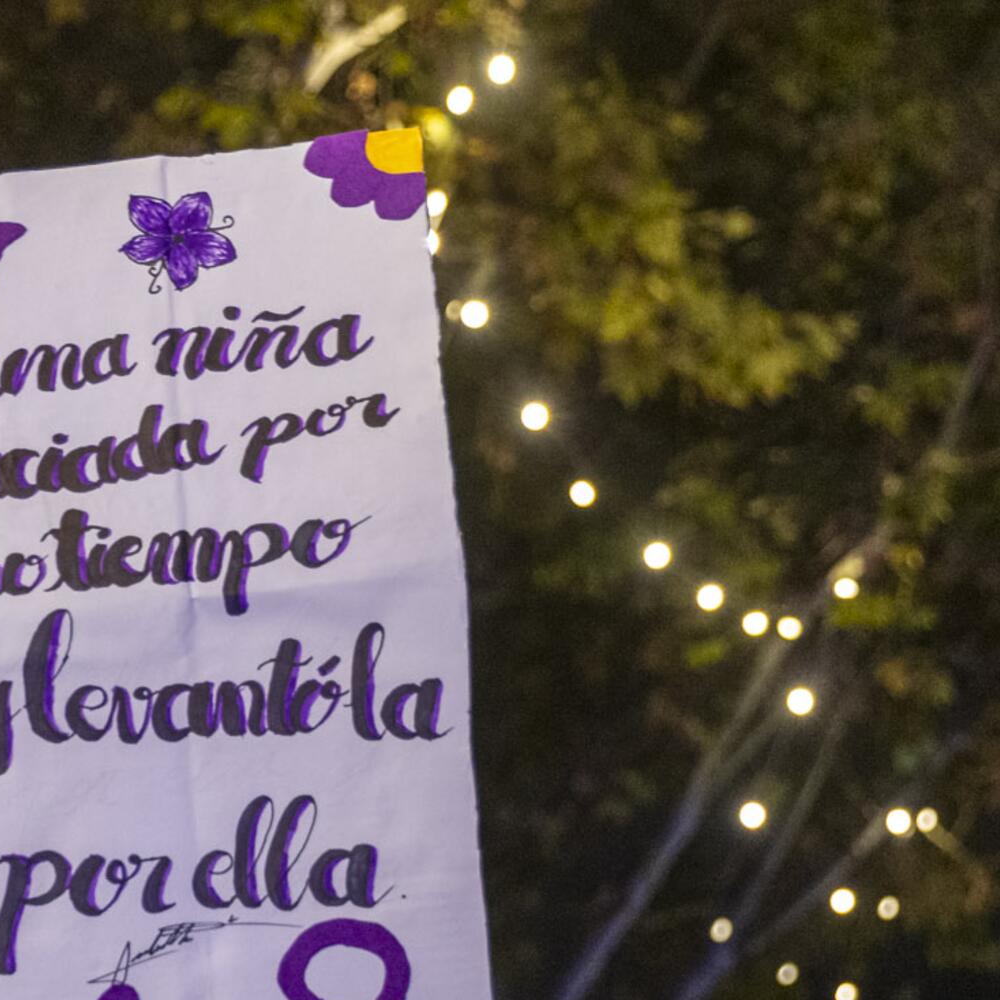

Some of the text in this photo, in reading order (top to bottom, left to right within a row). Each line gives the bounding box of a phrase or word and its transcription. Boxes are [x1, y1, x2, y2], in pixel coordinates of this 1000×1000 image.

[152, 305, 374, 380] niña
[240, 392, 400, 483] por
[41, 509, 371, 616] tiempo
[344, 621, 453, 742] la
